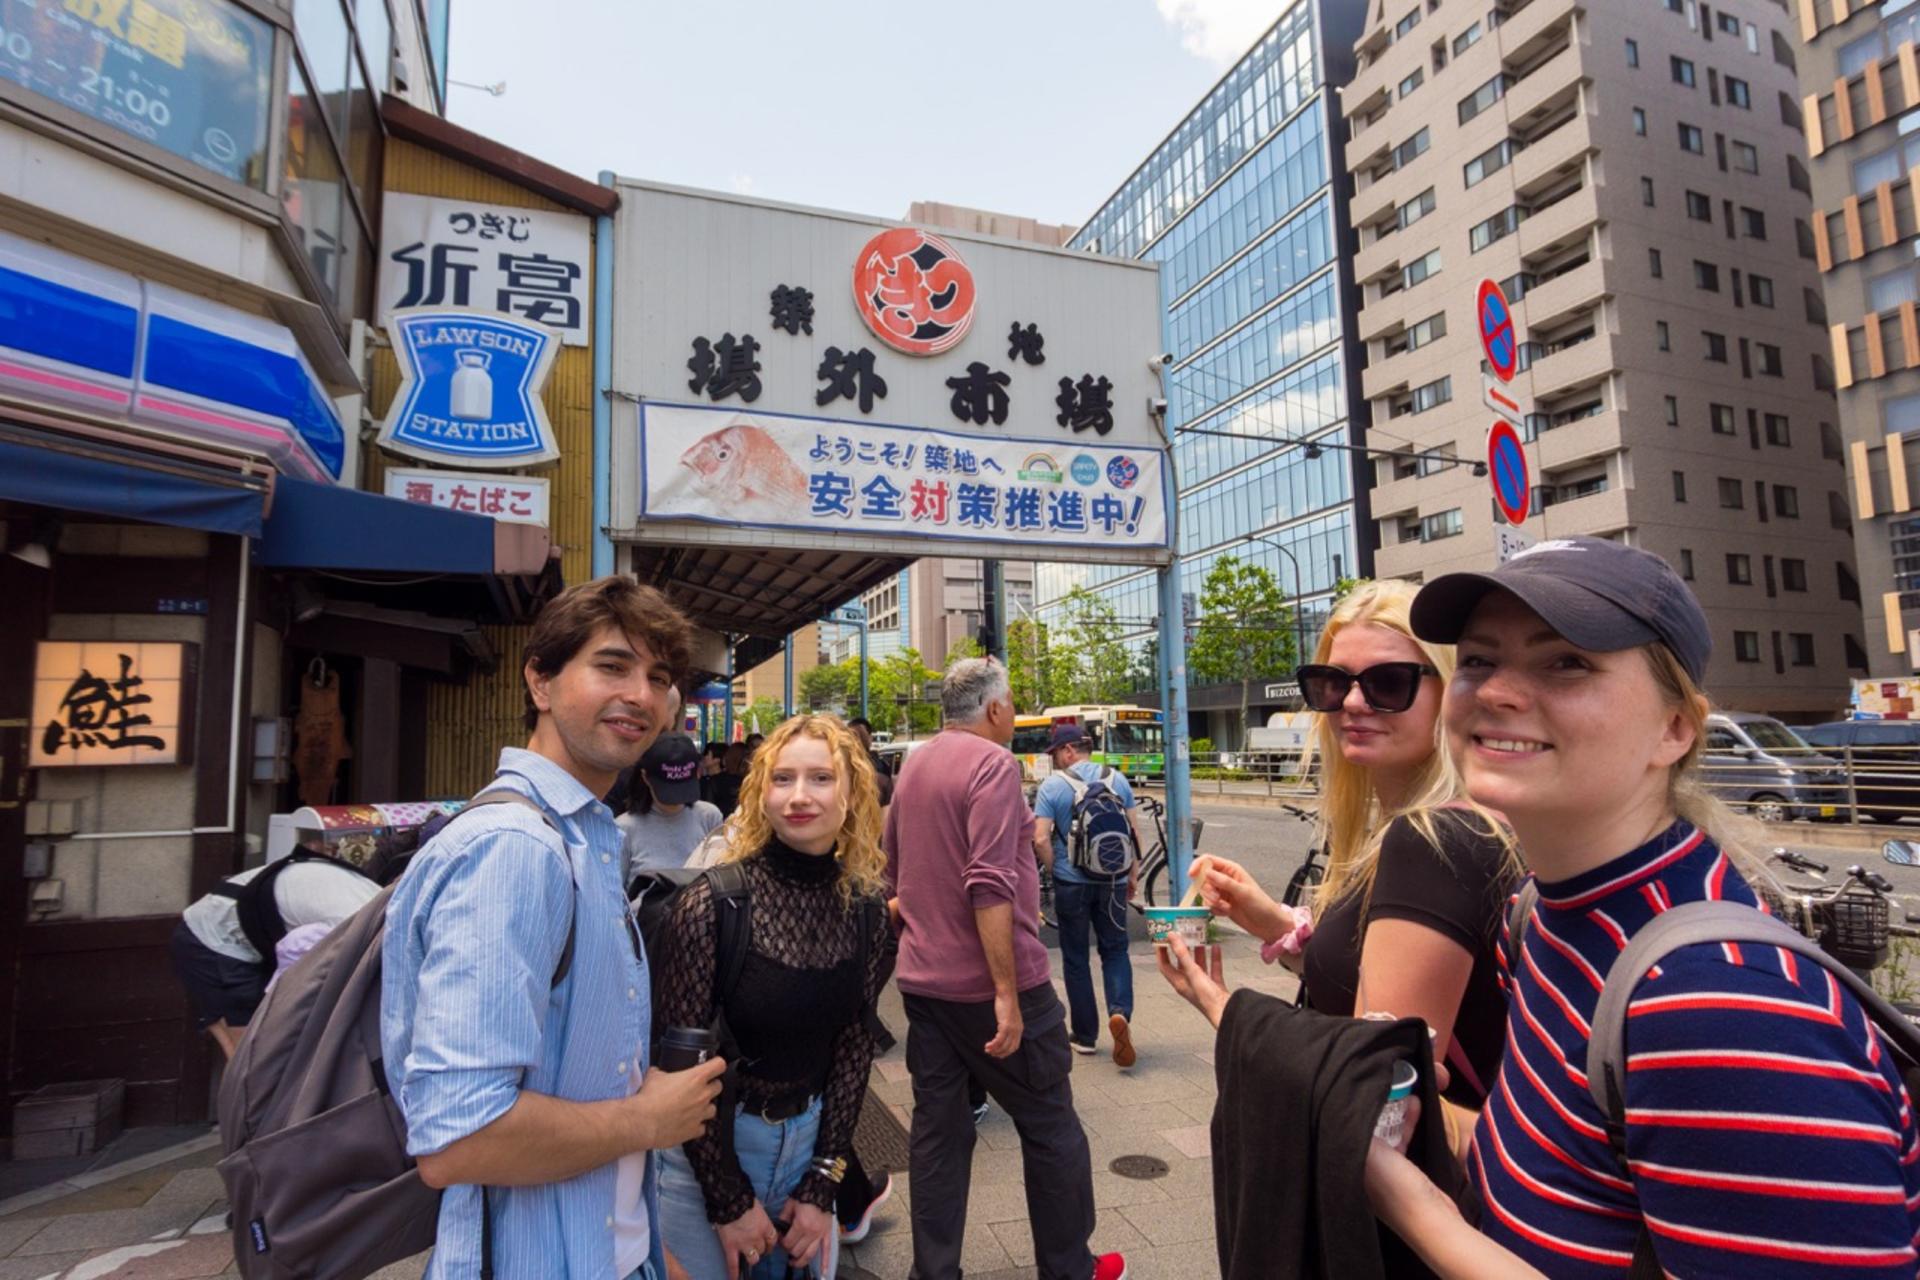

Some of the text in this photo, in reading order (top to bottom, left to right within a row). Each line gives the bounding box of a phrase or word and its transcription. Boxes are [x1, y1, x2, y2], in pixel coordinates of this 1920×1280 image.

[78, 65, 171, 127] 21:00
[448, 211, 531, 242] つきじ
[415, 327, 532, 358] LAWSON
[411, 413, 530, 442] STATION
[808, 470, 1147, 536] 安全対策推進中!
[41, 653, 166, 756] 鮭
